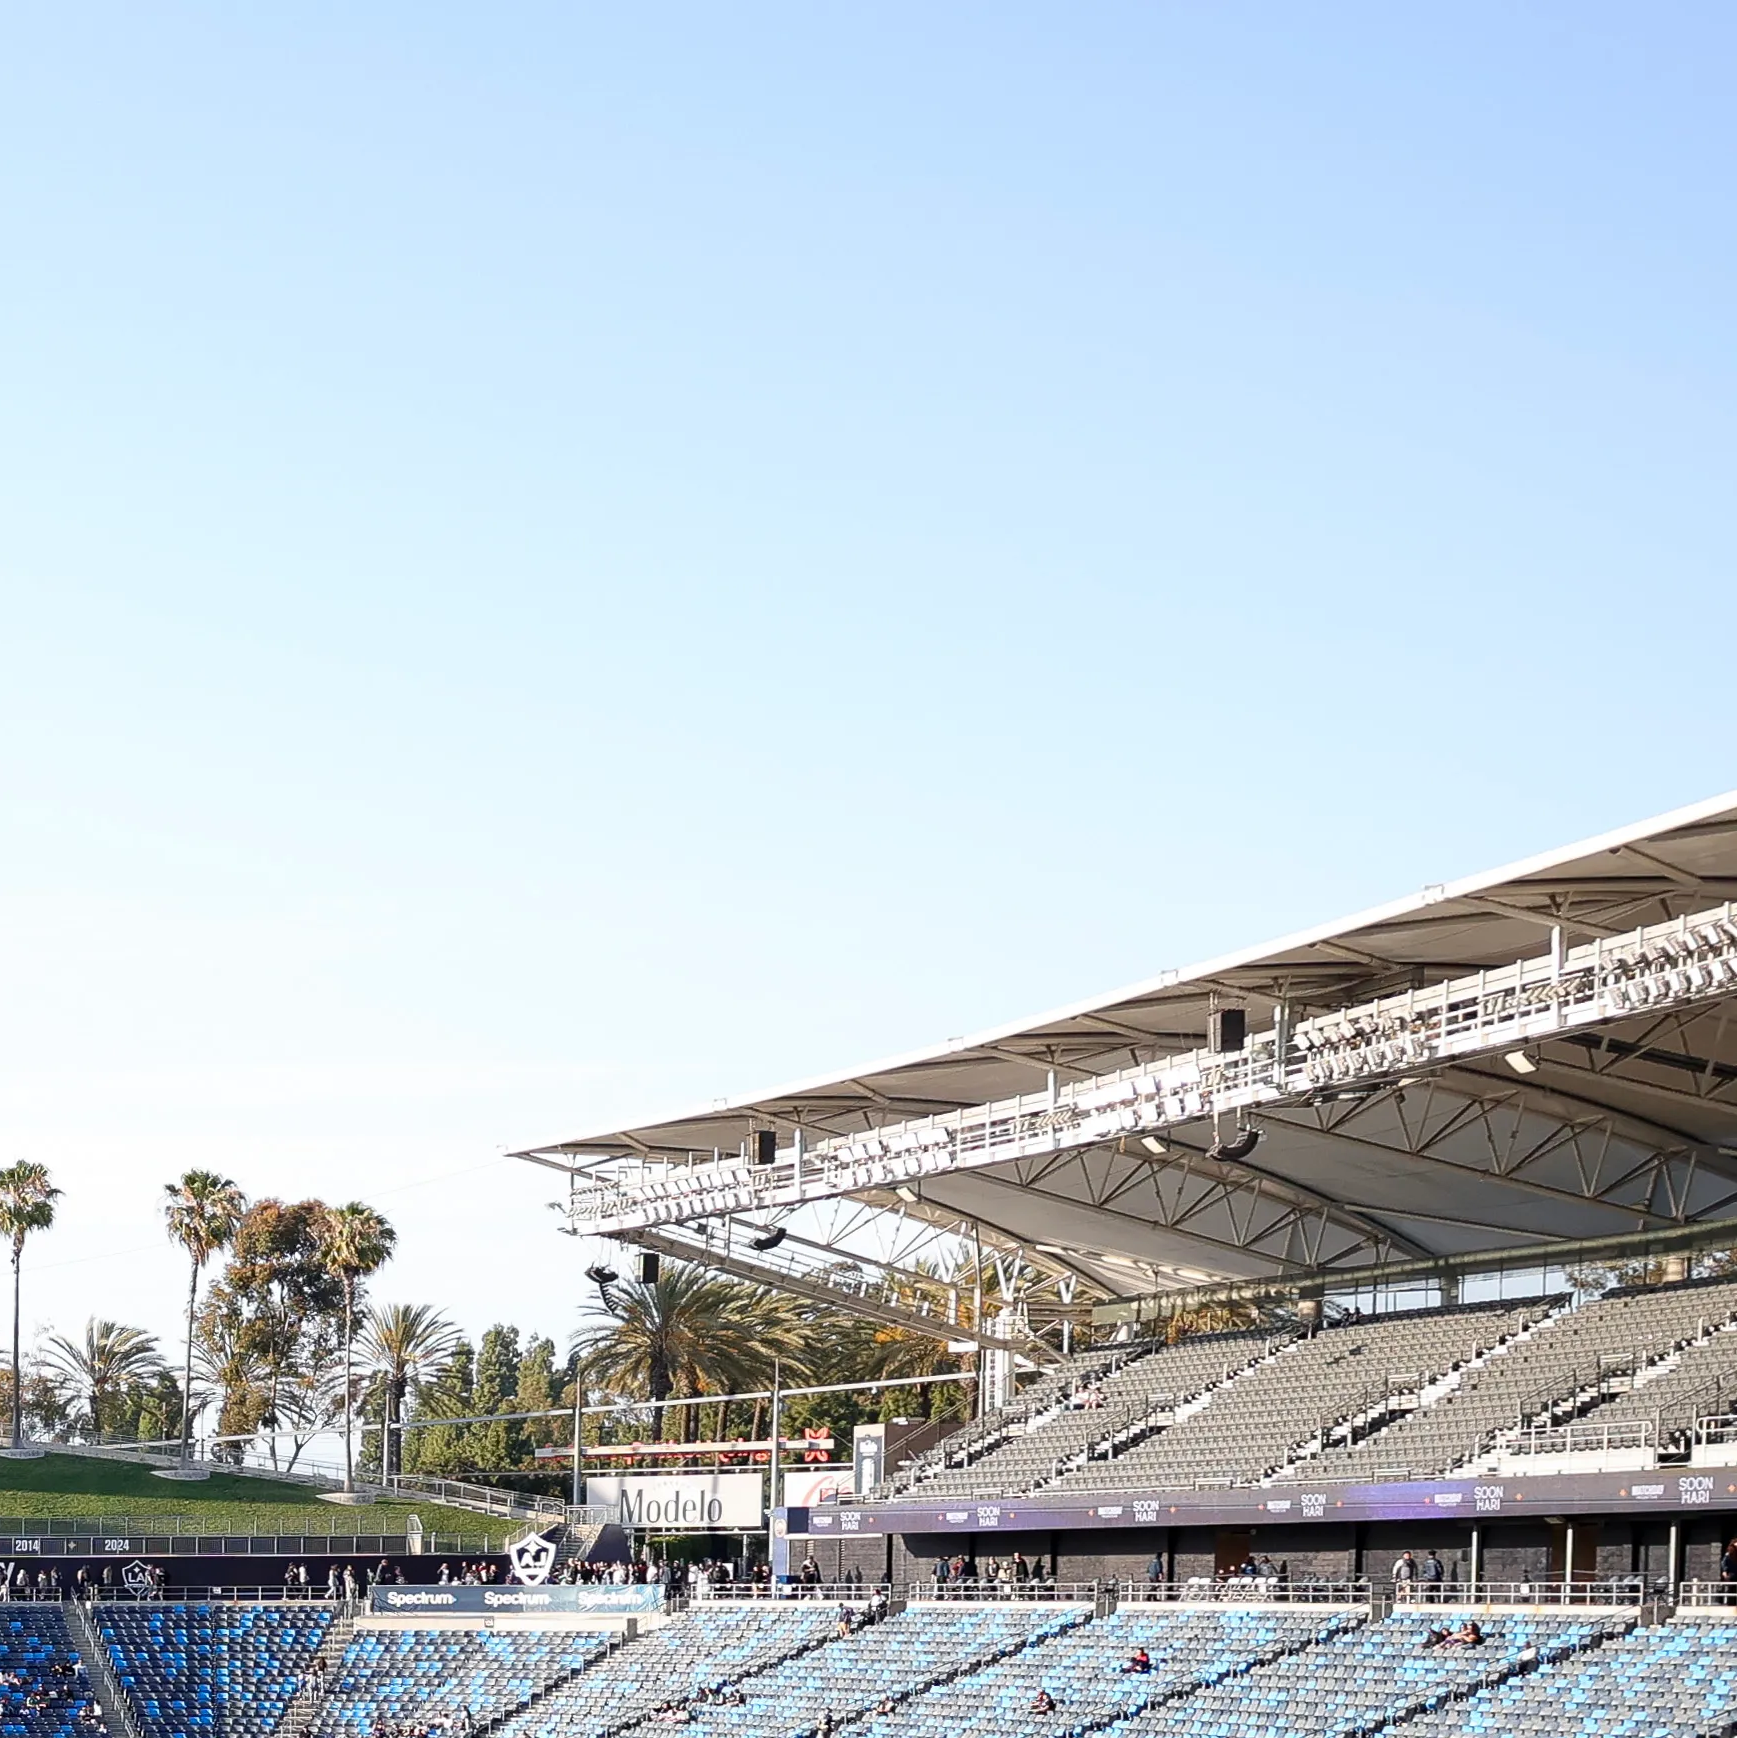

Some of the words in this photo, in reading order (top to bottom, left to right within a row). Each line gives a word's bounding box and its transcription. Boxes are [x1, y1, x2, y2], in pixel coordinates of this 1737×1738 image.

[1679, 1476, 1714, 1491] SOON
[1474, 1486, 1503, 1499] SOON
[1681, 1490, 1709, 1504] HARI
[620, 1489, 722, 1524] Modelo
[1301, 1494, 1325, 1506] SOON
[1477, 1498, 1500, 1511] HARI
[977, 1506, 1000, 1518] SOON
[1133, 1501, 1159, 1513] SOON
[1303, 1505, 1323, 1516] HARI
[979, 1516, 998, 1526] HARI
[1135, 1511, 1157, 1522] HARI
[15, 1540, 40, 1552] 2014
[105, 1539, 130, 1551] 2024
[128, 1572, 145, 1583] LA
[387, 1592, 453, 1608] Spectrum
[484, 1591, 549, 1608] Spectrum
[579, 1591, 641, 1607] Spectrum
